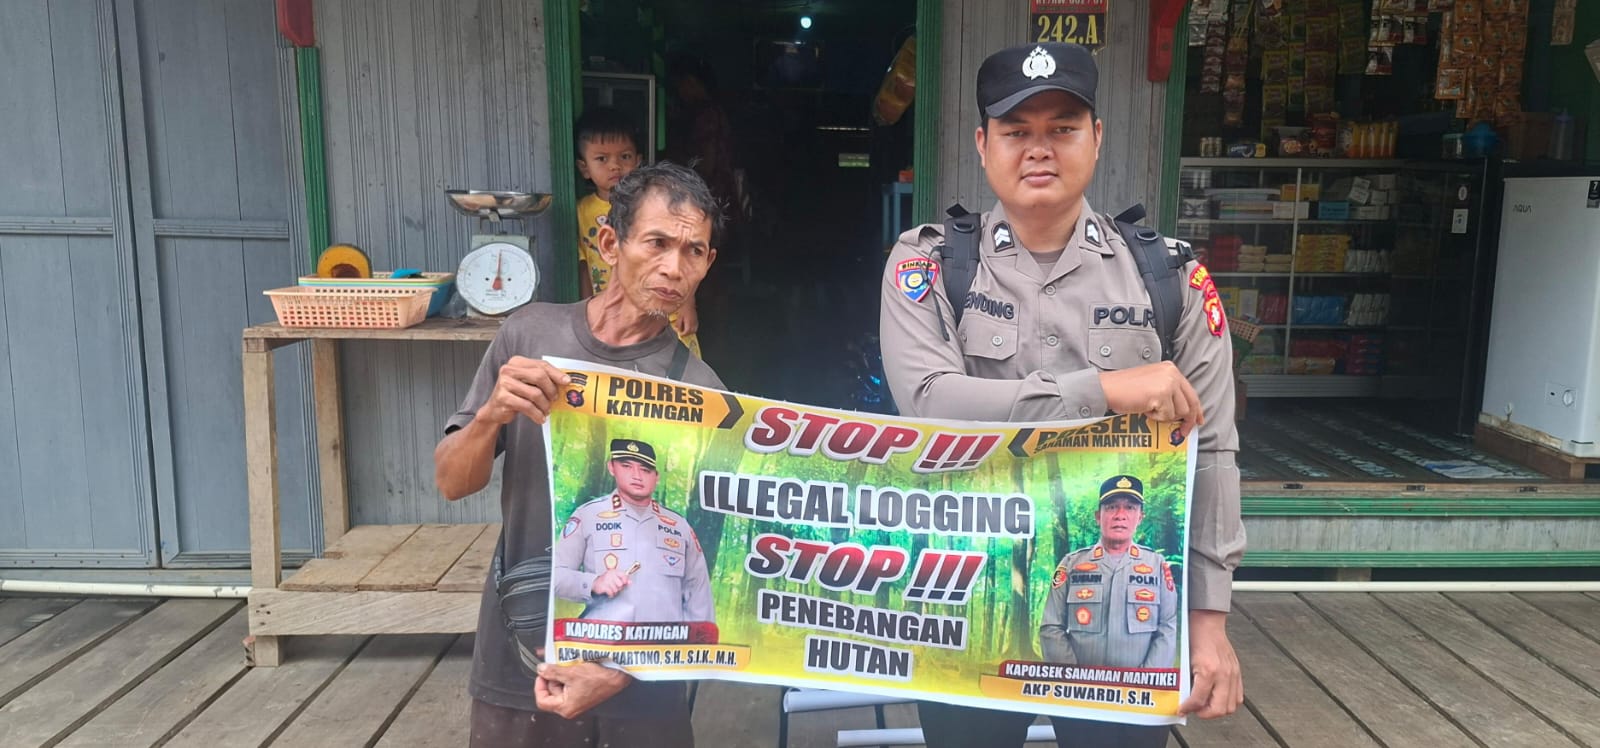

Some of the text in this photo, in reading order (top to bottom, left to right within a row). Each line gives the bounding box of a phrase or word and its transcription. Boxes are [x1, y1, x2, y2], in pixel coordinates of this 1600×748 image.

[1037, 15, 1098, 44] 242.A
[608, 376, 704, 405] POLRES
[606, 400, 704, 423] KATINGAN
[750, 406, 1001, 470] STOP !!!
[1092, 434, 1152, 448] MANTIKEI
[703, 475, 1031, 535] ILLEGAL LOGGING
[596, 522, 622, 531] DODIK
[748, 536, 984, 601] STOP !!!
[1129, 575, 1158, 586] POLRI
[761, 592, 964, 647] PENEBANGAN
[565, 622, 689, 641] KAPOLRES KATINGAN
[716, 651, 737, 665] M.H.
[807, 638, 910, 677] HUTAN
[1005, 663, 1177, 686] KAPOLSEK SANAMAN MANTIKEI
[1022, 683, 1155, 706] AKP SUWARDI, S.H.
